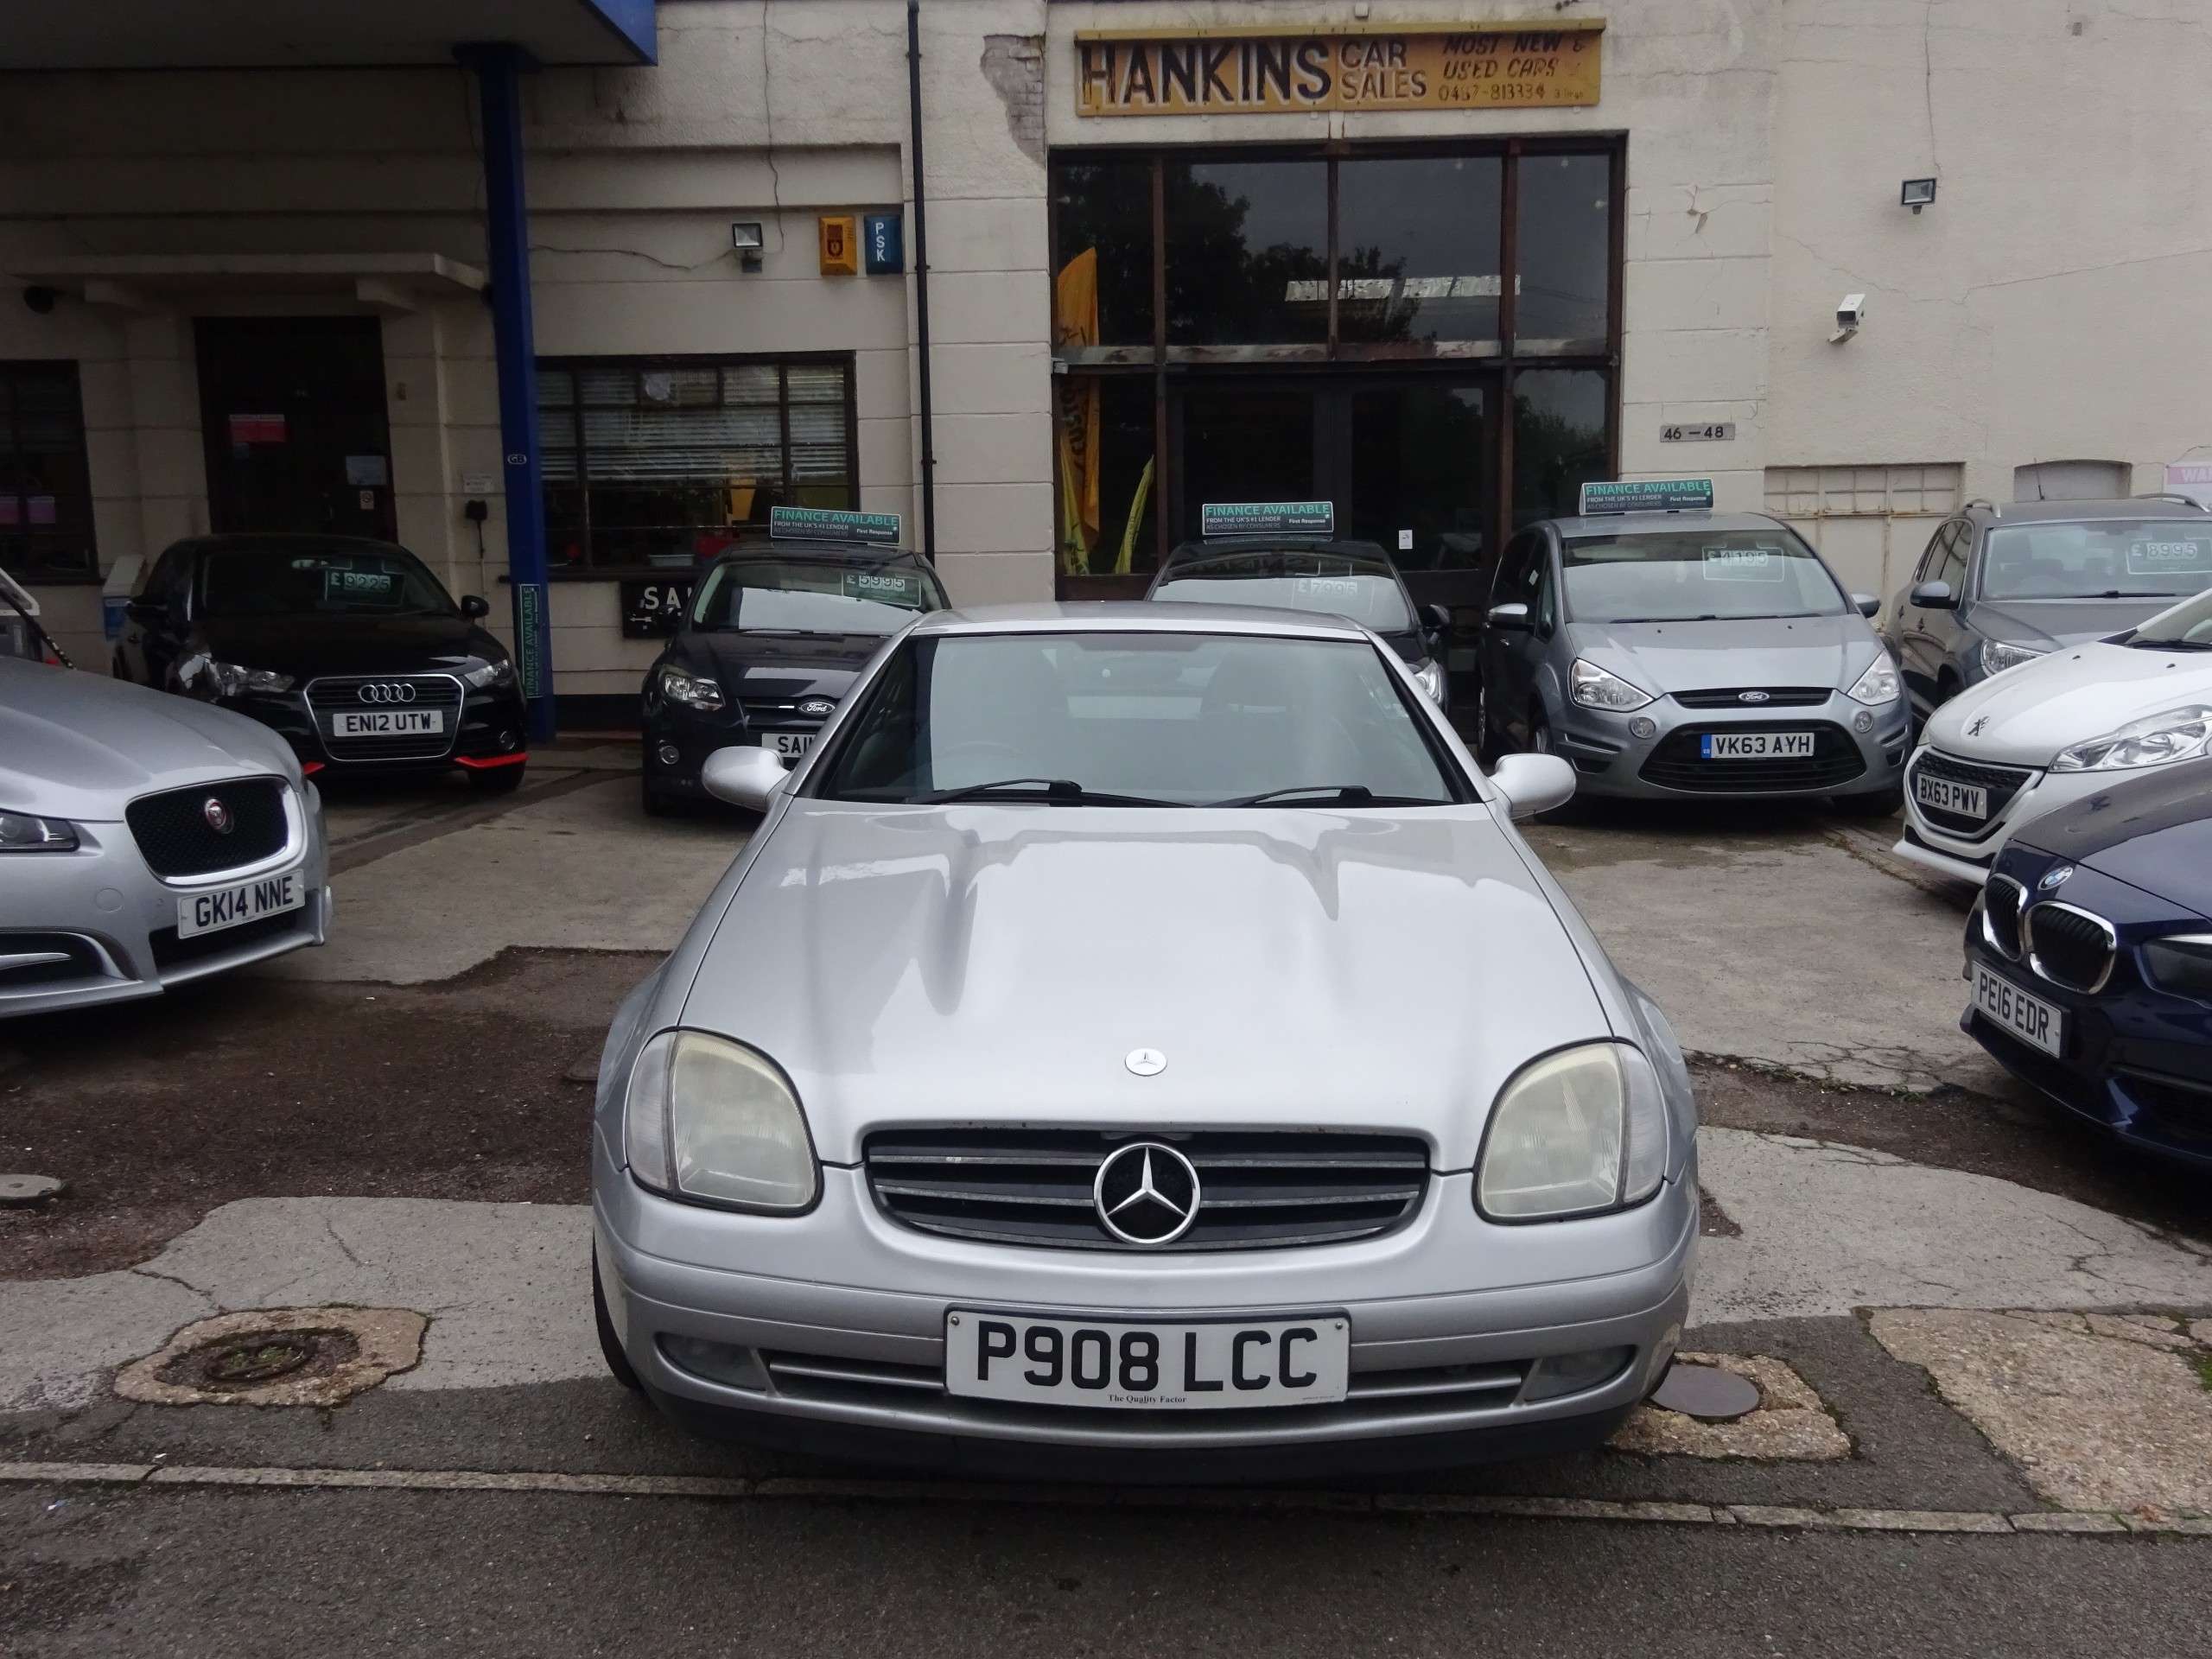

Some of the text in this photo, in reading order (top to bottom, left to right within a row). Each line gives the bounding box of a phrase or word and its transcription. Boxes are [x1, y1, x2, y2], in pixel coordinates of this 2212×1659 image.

[1340, 40, 1408, 68] CAR
[1443, 33, 1503, 55] MOST
[1511, 32, 1561, 54] NEW
[1080, 40, 1332, 104] HANKINS
[1443, 56, 1560, 80] USED CARS
[1340, 69, 1427, 100] SALES
[874, 221, 886, 262] PSK
[1586, 480, 1710, 496] FINANCE AVAILABLE
[773, 510, 898, 526] FINANCE AVAILABLE
[1205, 504, 1330, 516] FINANCE AVAILABLE
[2131, 543, 2197, 560] £8995
[330, 572, 391, 593] £9225
[644, 586, 692, 610] SA
[523, 587, 535, 696] FINANCE AVAILABLE
[806, 701, 828, 712] Ford
[346, 712, 435, 733] EN12 UTW
[1715, 736, 1767, 756] VK63
[1771, 735, 1810, 753] AYH
[1920, 775, 1981, 813] BX63 PWV
[195, 876, 293, 927] GK14 NNE
[1979, 970, 2050, 1045] PE16 EDR
[977, 1320, 1319, 1392] P908 LCC
[1109, 1394, 1124, 1402] The
[1126, 1395, 1157, 1404] Quality
